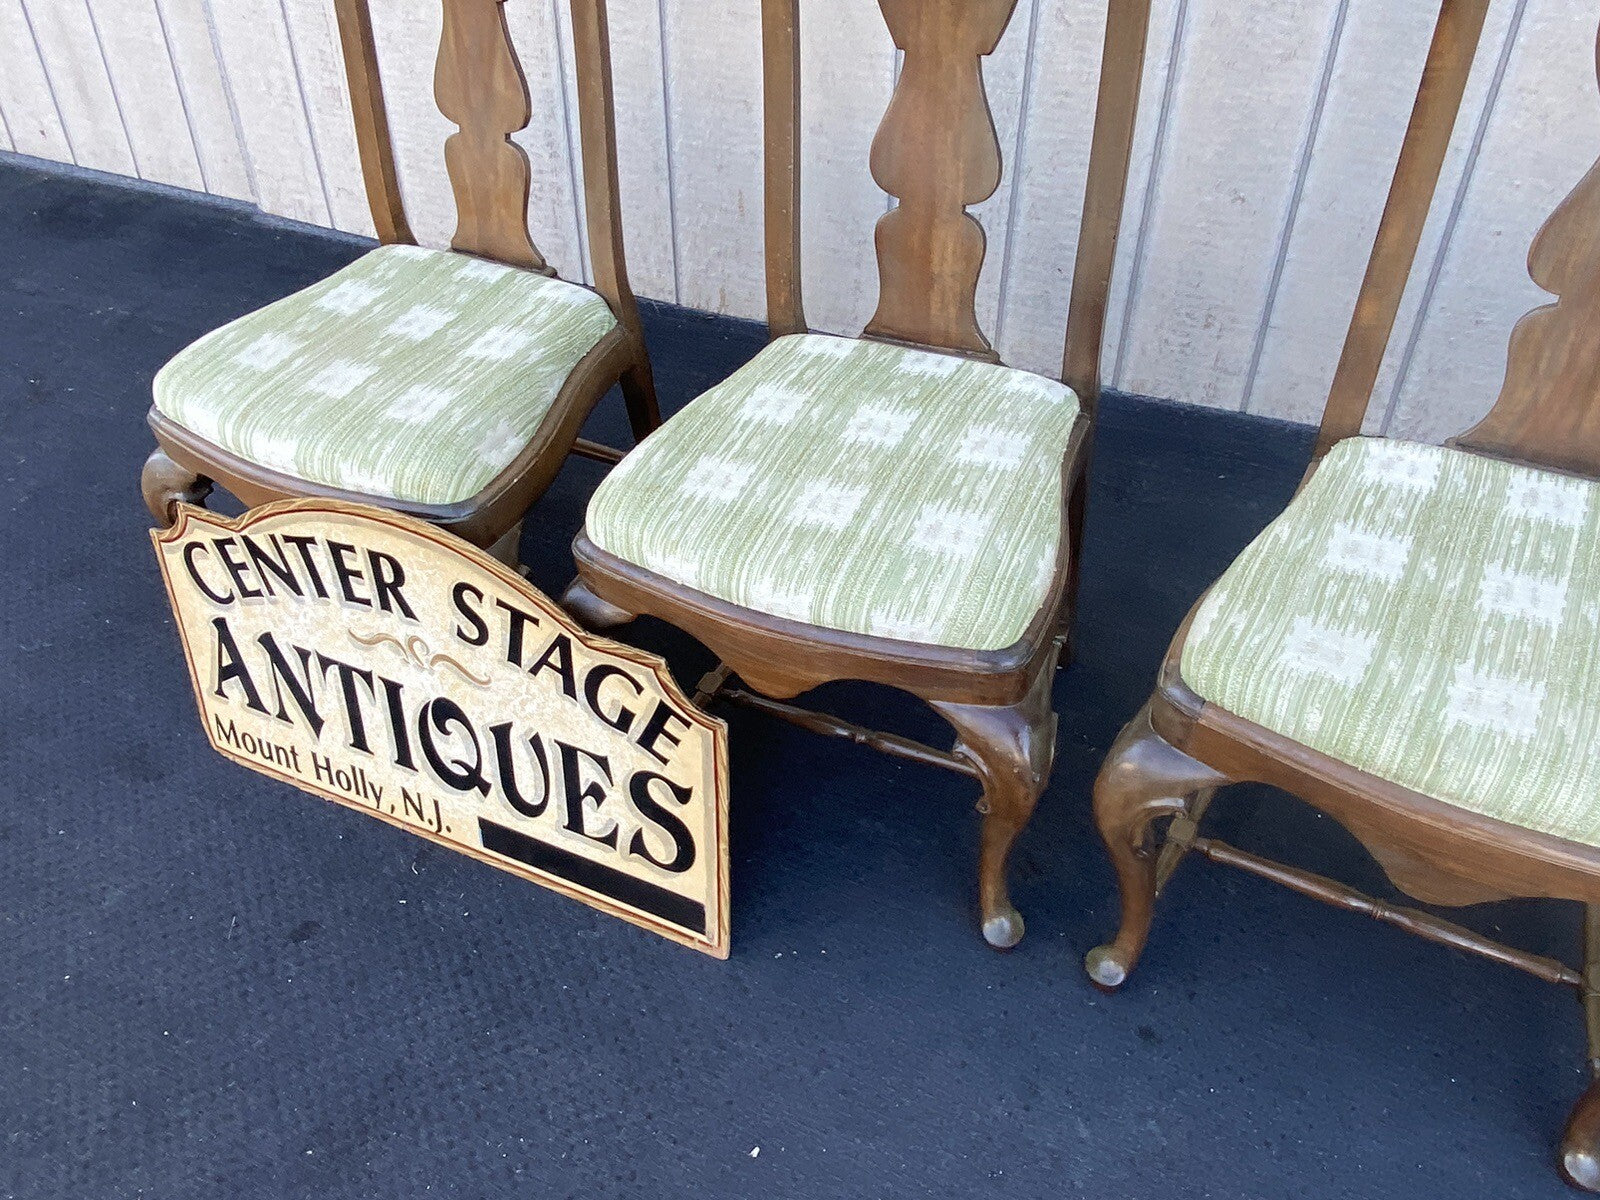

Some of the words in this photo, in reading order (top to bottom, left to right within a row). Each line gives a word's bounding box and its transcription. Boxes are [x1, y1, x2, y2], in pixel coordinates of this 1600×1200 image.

[183, 534, 420, 622] CENTER
[453, 582, 692, 766] STAGE
[212, 617, 696, 872] ANTIQUES
[215, 713, 302, 773] Mount
[311, 751, 395, 814] Holly,
[401, 786, 452, 833] N.J.
